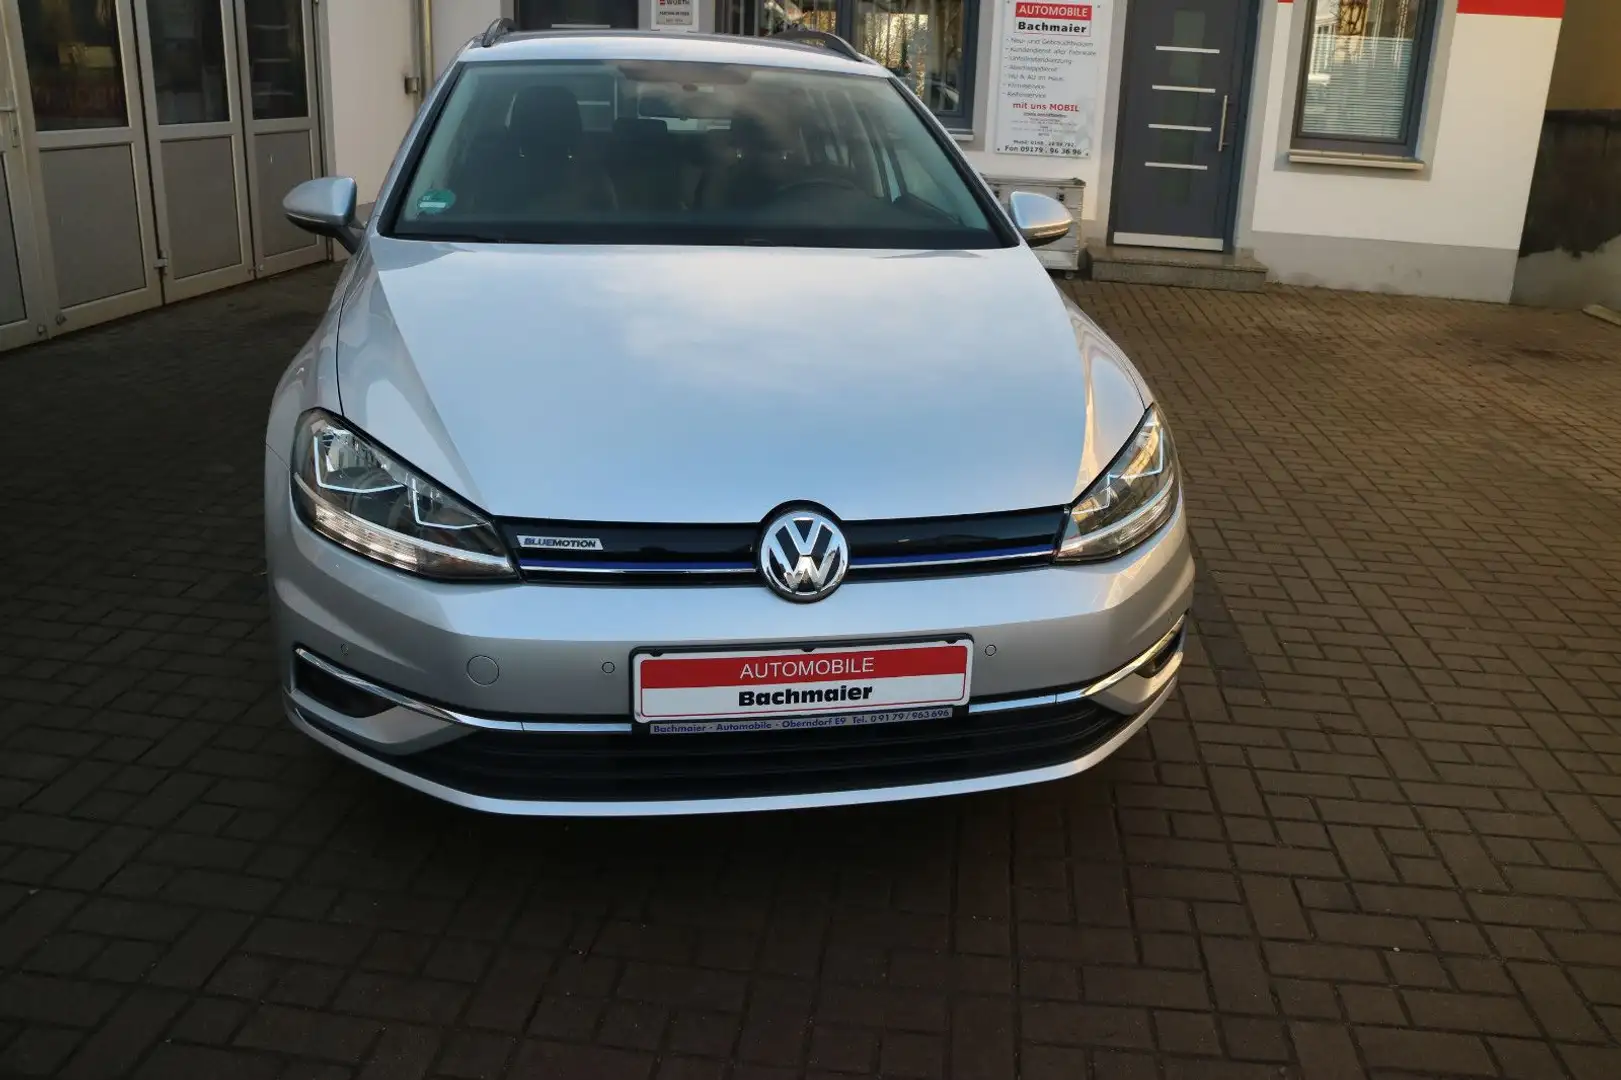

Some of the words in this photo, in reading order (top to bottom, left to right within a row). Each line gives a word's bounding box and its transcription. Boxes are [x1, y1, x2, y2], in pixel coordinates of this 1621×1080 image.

[1019, 5, 1088, 17] AUTOMOBILE
[1018, 21, 1087, 33] Bachmaier
[1049, 103, 1080, 112] MOBIL
[524, 538, 596, 548] BLUEMOTION
[739, 657, 875, 679] AUTOMOBILE
[738, 685, 873, 706] Bachmaier
[653, 723, 706, 733] Bachmaier
[716, 722, 772, 732] Automobile
[782, 717, 834, 729] Oberndorf
[834, 717, 846, 725] E9
[852, 714, 868, 724] Tel.
